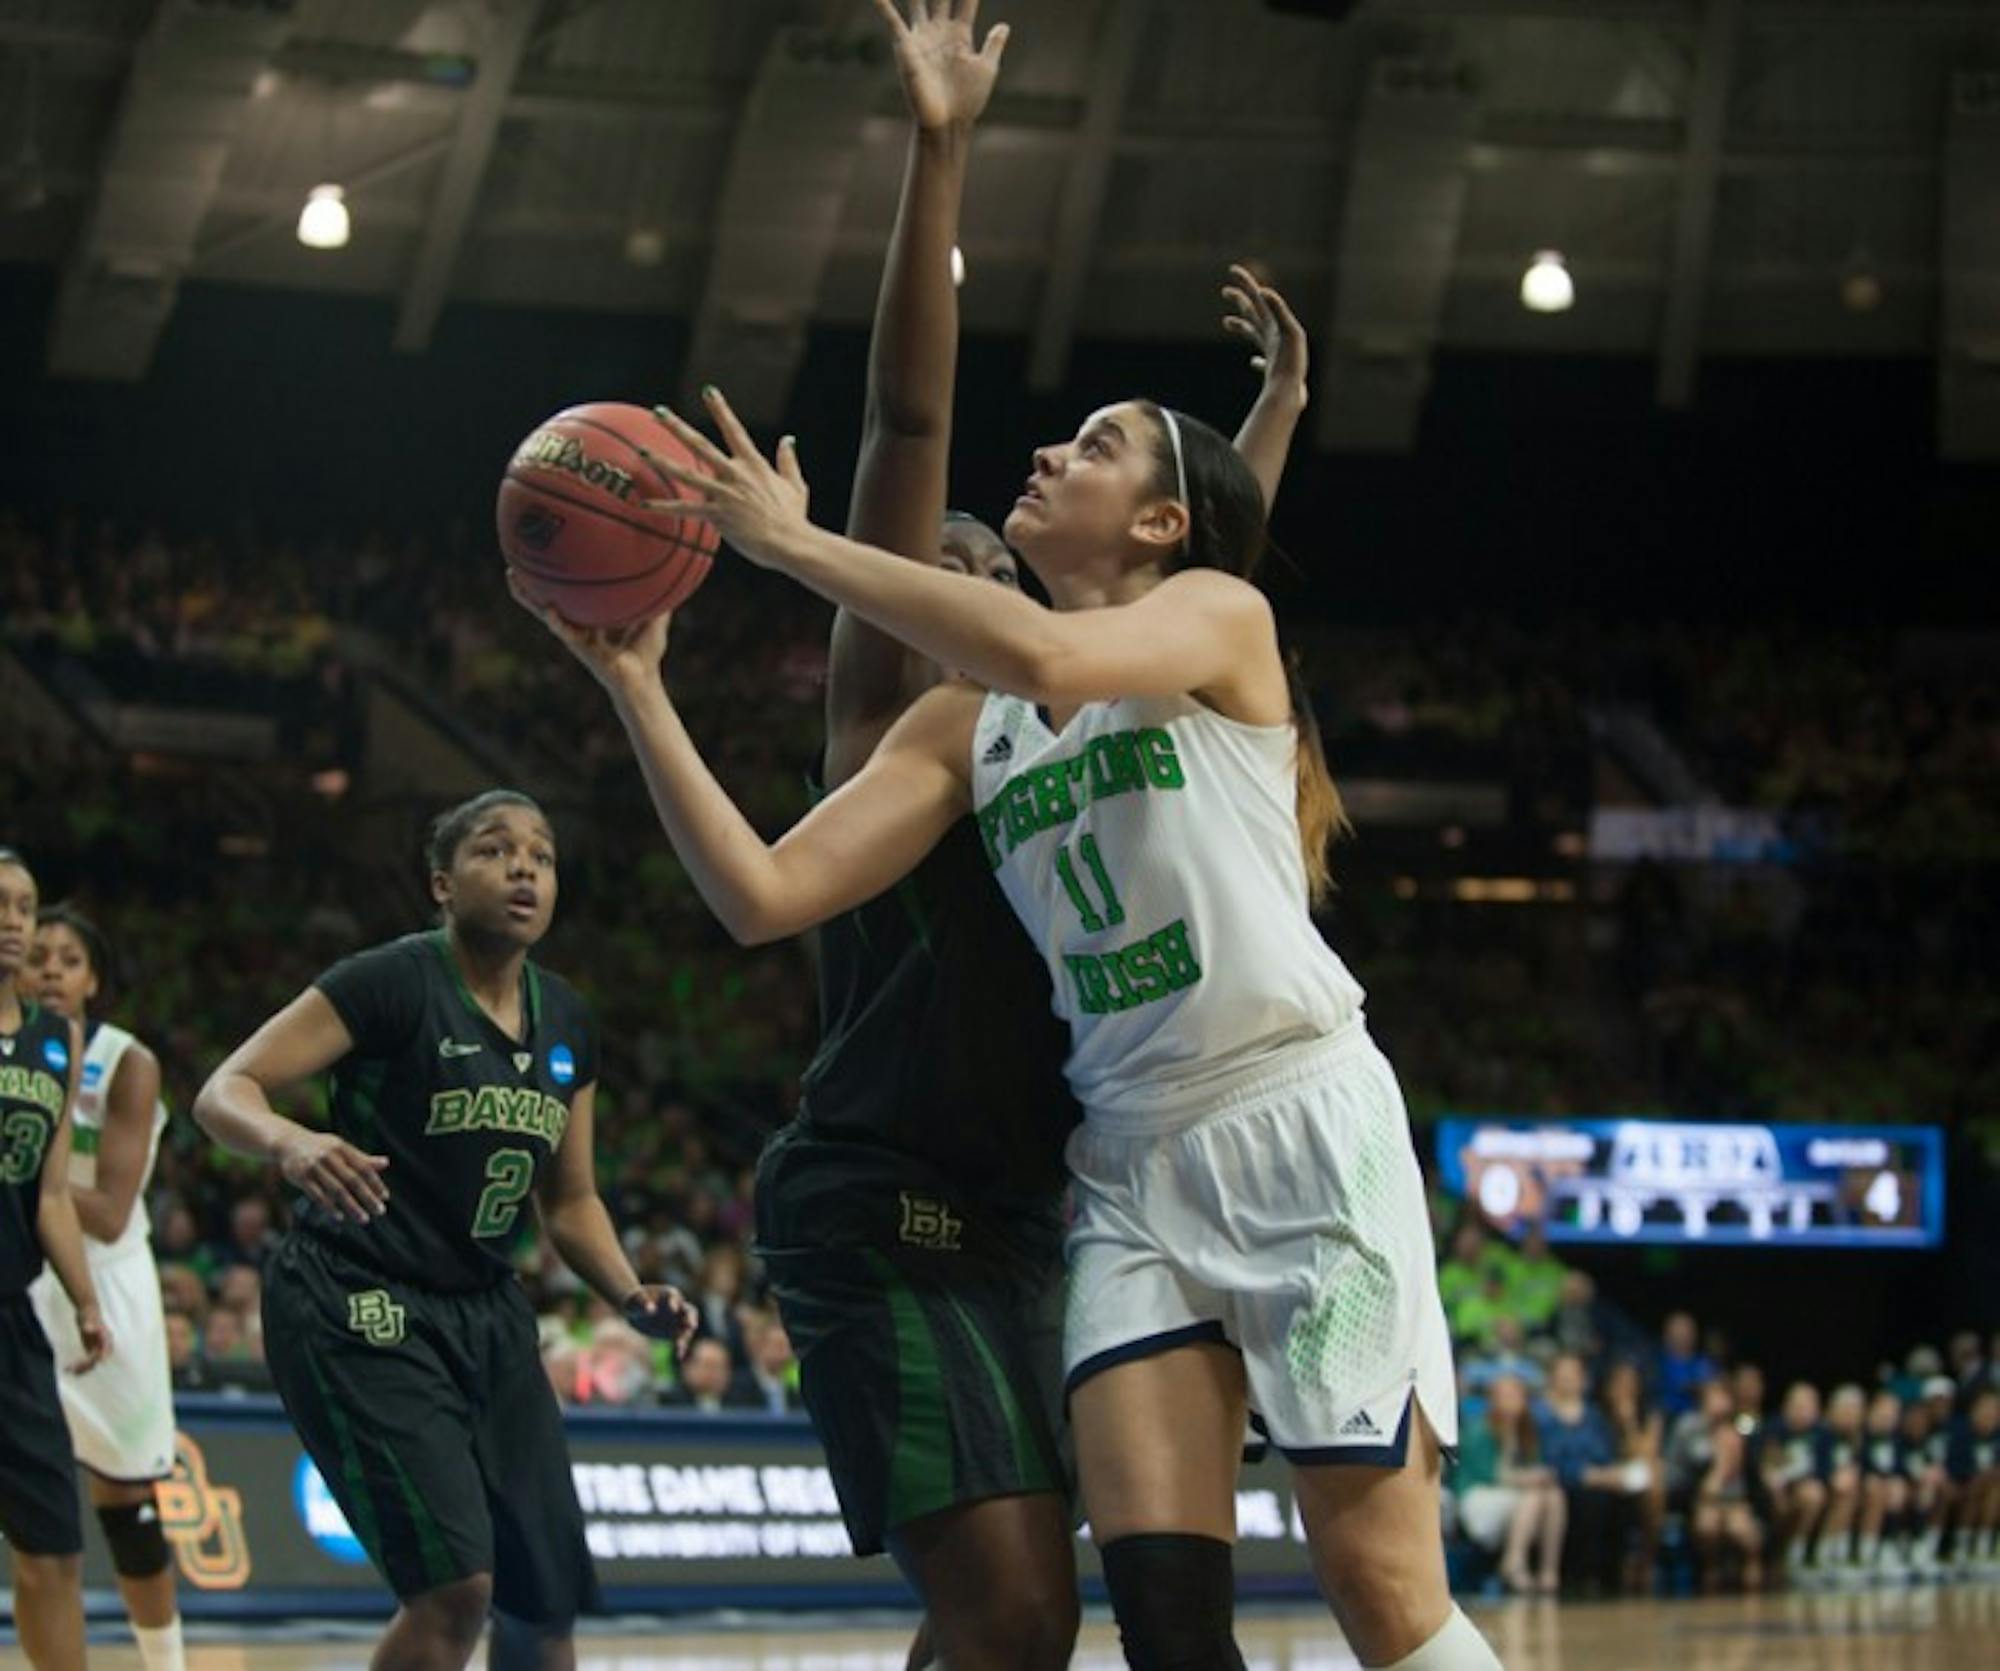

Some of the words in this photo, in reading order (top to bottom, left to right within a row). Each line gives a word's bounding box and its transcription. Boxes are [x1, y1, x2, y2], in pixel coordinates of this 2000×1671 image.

[1056, 832, 1126, 934] 11
[1063, 918, 1203, 1015] IRISH
[470, 1147, 534, 1238] 2
[347, 1289, 404, 1347] BU
